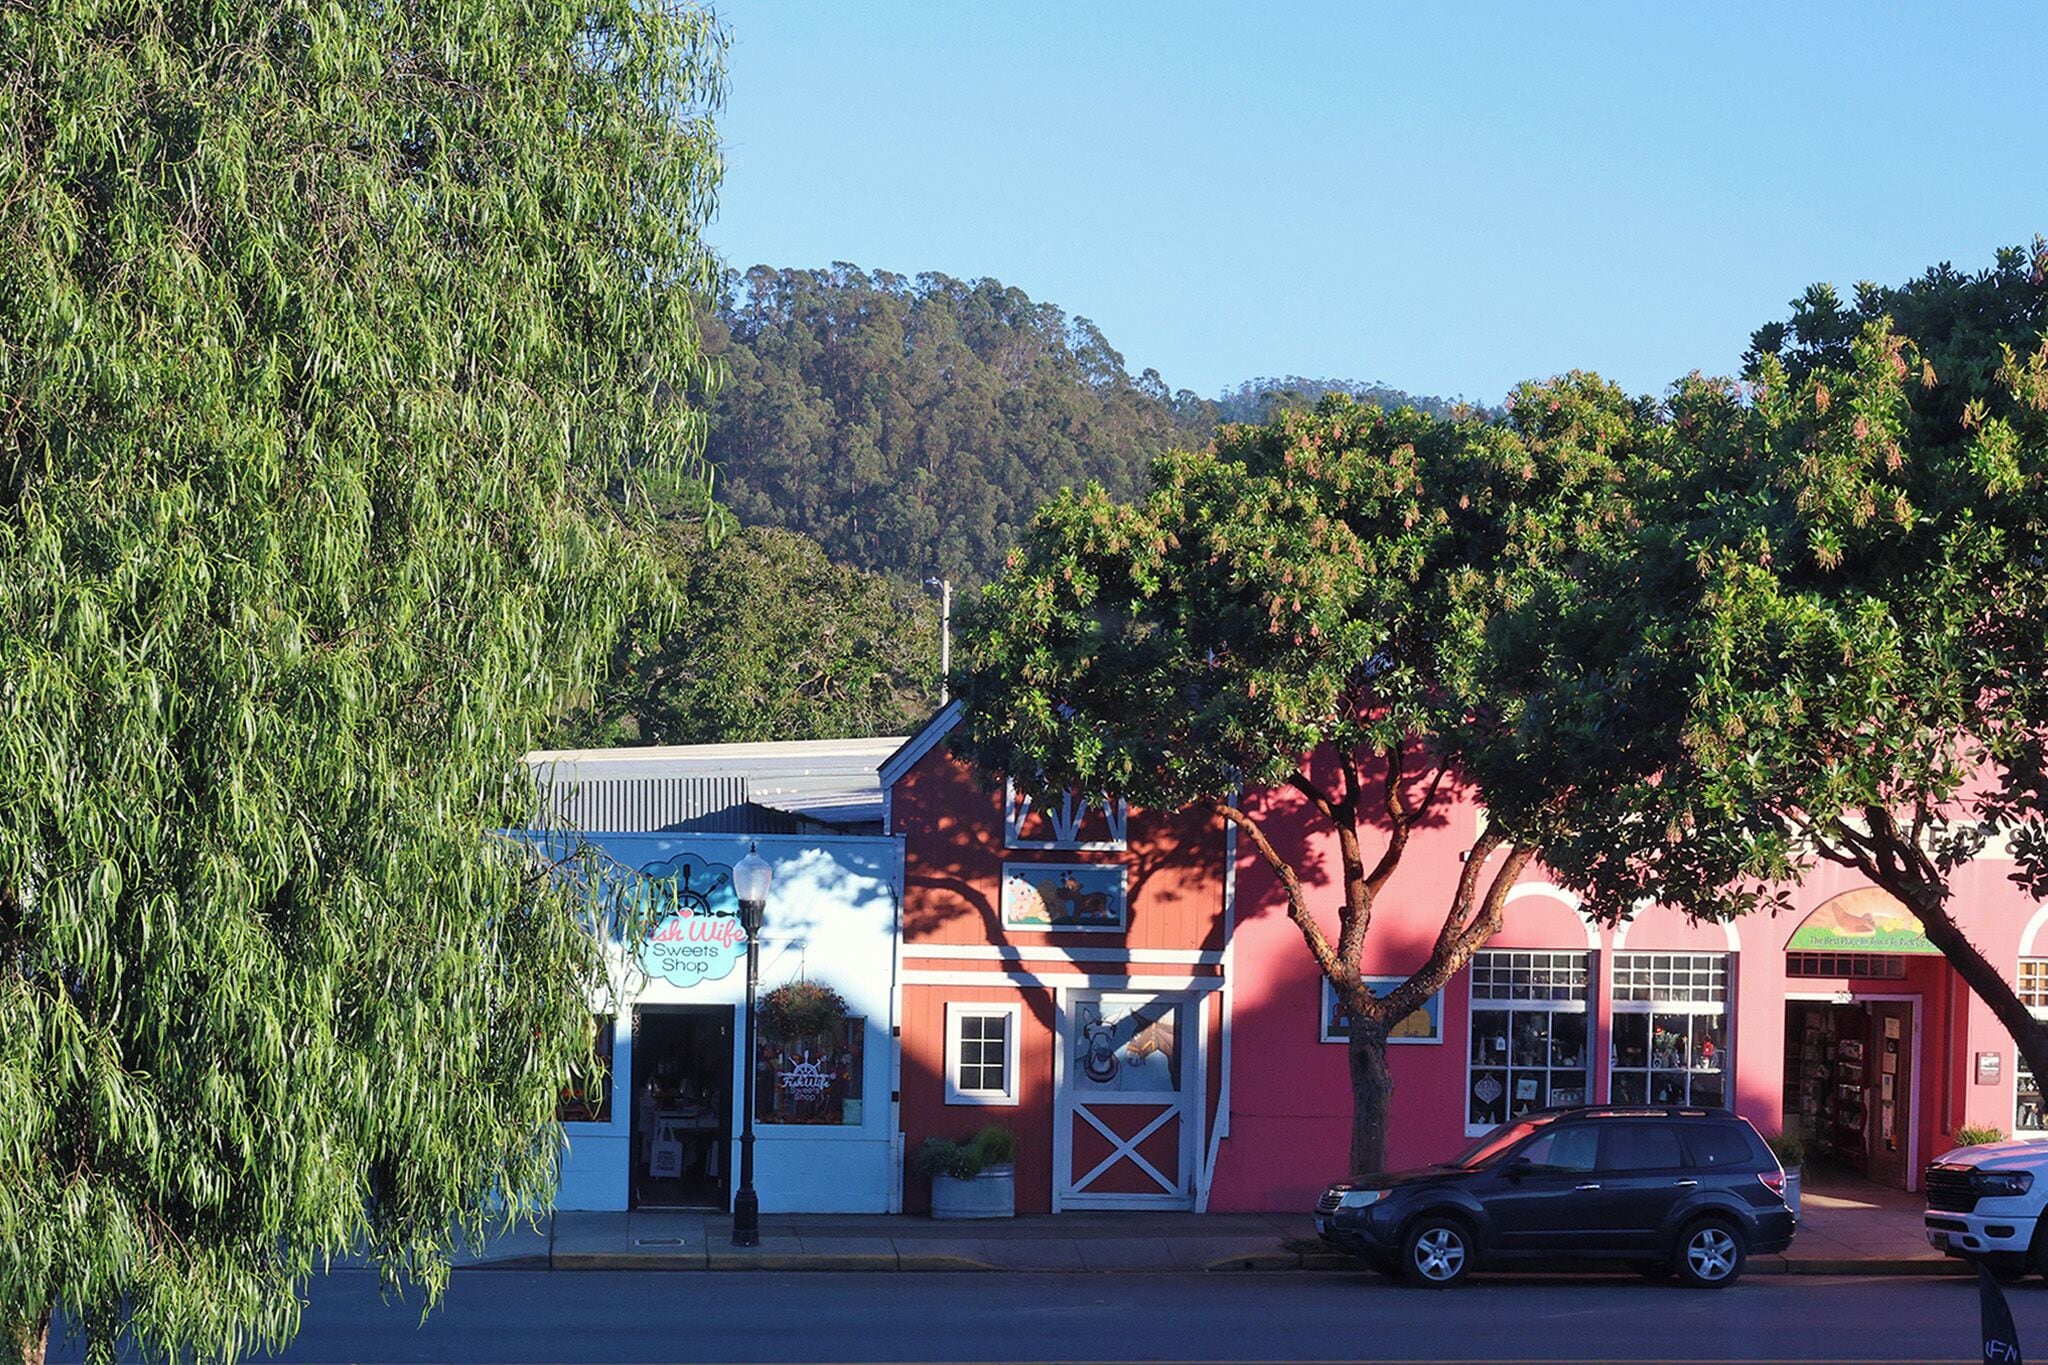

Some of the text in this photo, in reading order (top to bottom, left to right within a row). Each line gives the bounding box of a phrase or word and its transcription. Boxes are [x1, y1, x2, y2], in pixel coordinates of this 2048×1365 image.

[640, 918, 747, 949] ish Wife
[1823, 936, 1840, 946] Best
[652, 943, 718, 957] Sweets
[661, 957, 709, 974] Shop
[794, 1092, 816, 1102] Shop
